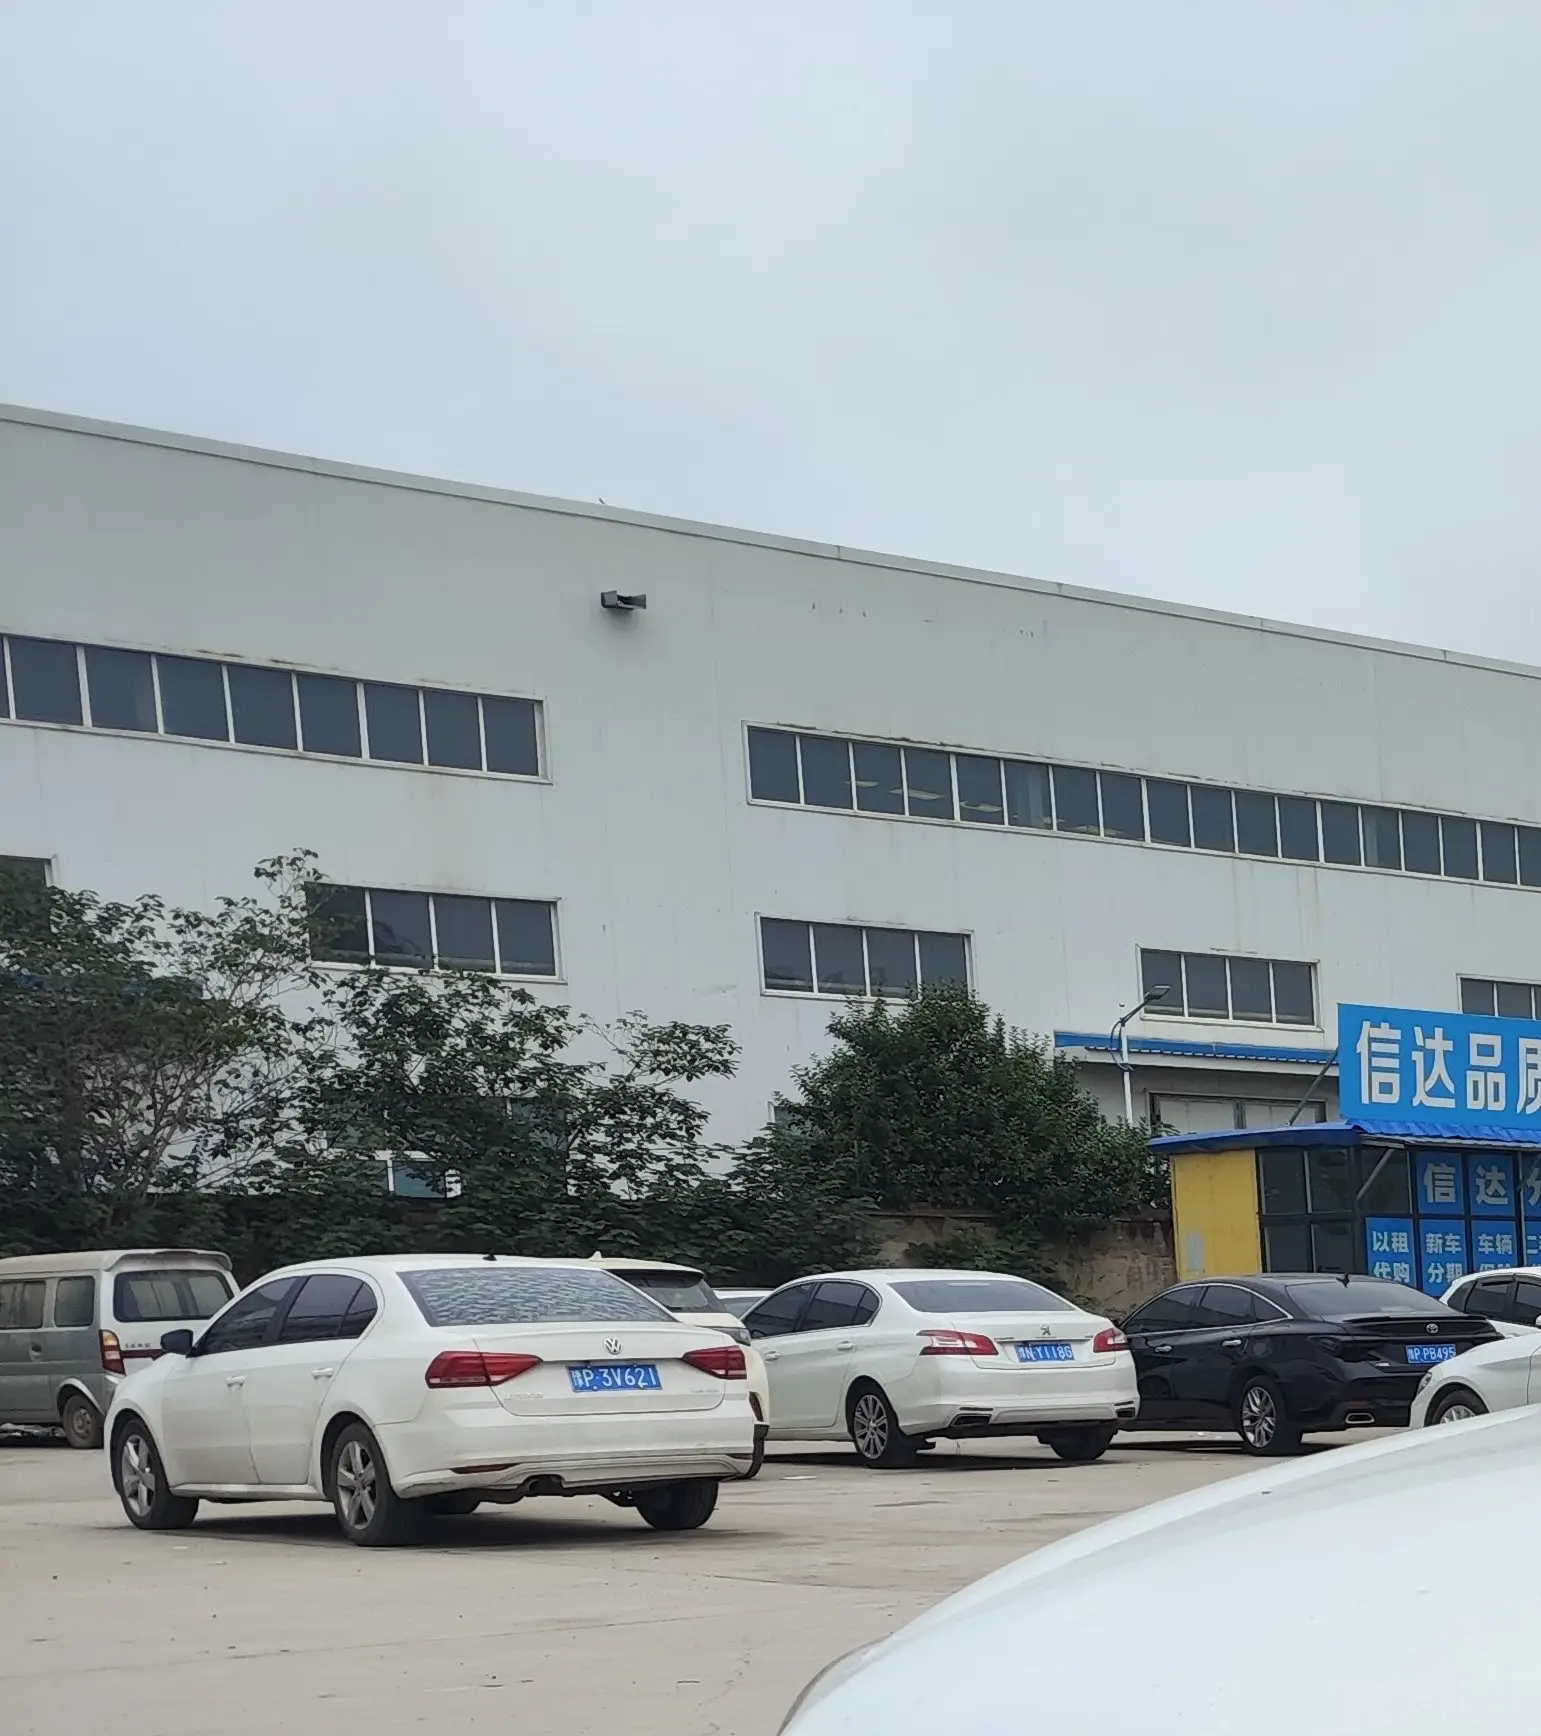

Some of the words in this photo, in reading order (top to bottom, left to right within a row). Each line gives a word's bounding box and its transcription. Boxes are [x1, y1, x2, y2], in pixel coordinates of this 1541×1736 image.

[1372, 1230, 1410, 1254] 以租
[1425, 1232, 1462, 1255] 新车
[1478, 1233, 1513, 1256] 车辆
